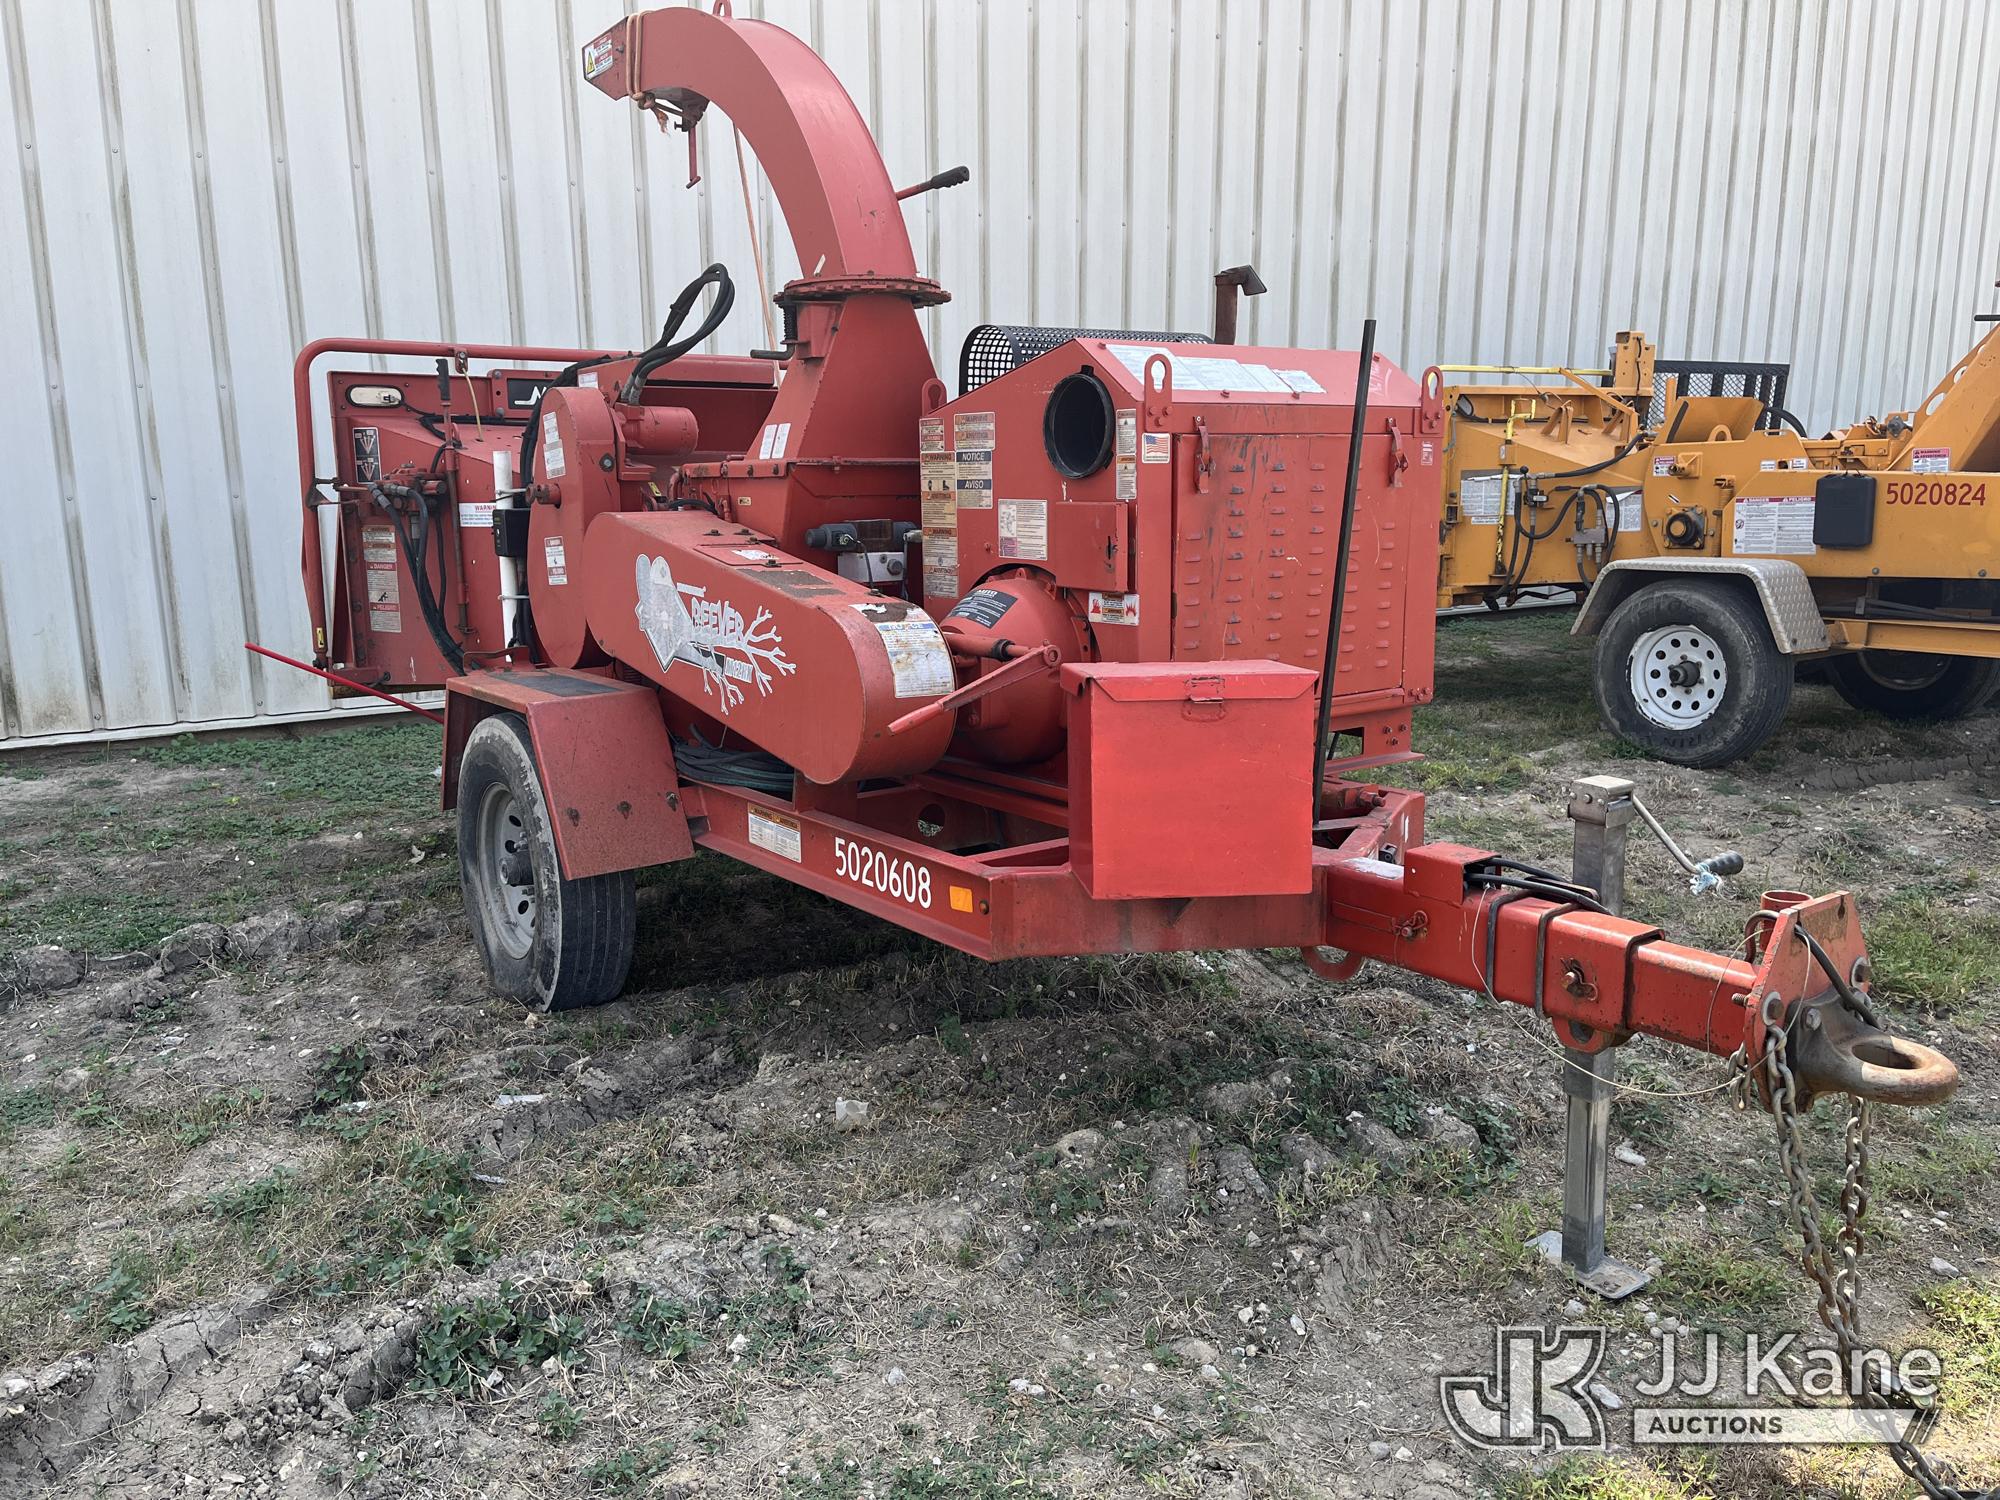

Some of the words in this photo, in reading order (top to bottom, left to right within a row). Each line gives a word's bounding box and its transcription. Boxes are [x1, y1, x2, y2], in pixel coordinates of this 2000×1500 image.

[962, 452, 985, 461] NOTICE
[964, 481, 984, 489] AVISO
[1886, 482, 1986, 506] 5020824
[834, 836, 932, 909] 5020608
